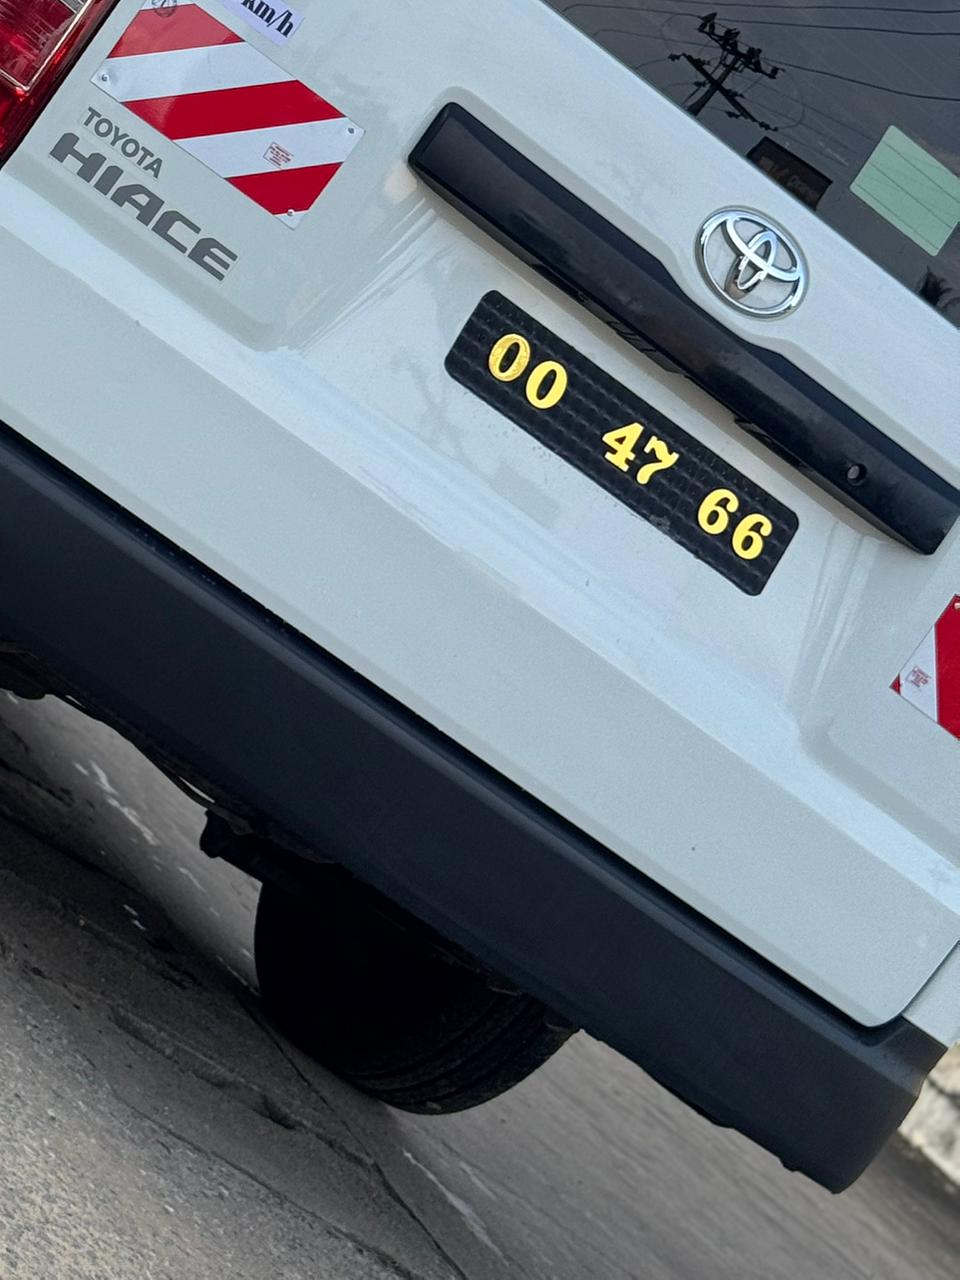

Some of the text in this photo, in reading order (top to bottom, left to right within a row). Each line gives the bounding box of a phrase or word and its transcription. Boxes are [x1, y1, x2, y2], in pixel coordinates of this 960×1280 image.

[49, 132, 239, 282] HIACE
[83, 107, 163, 179] TOYOTA
[488, 333, 773, 560] 00 47 66
